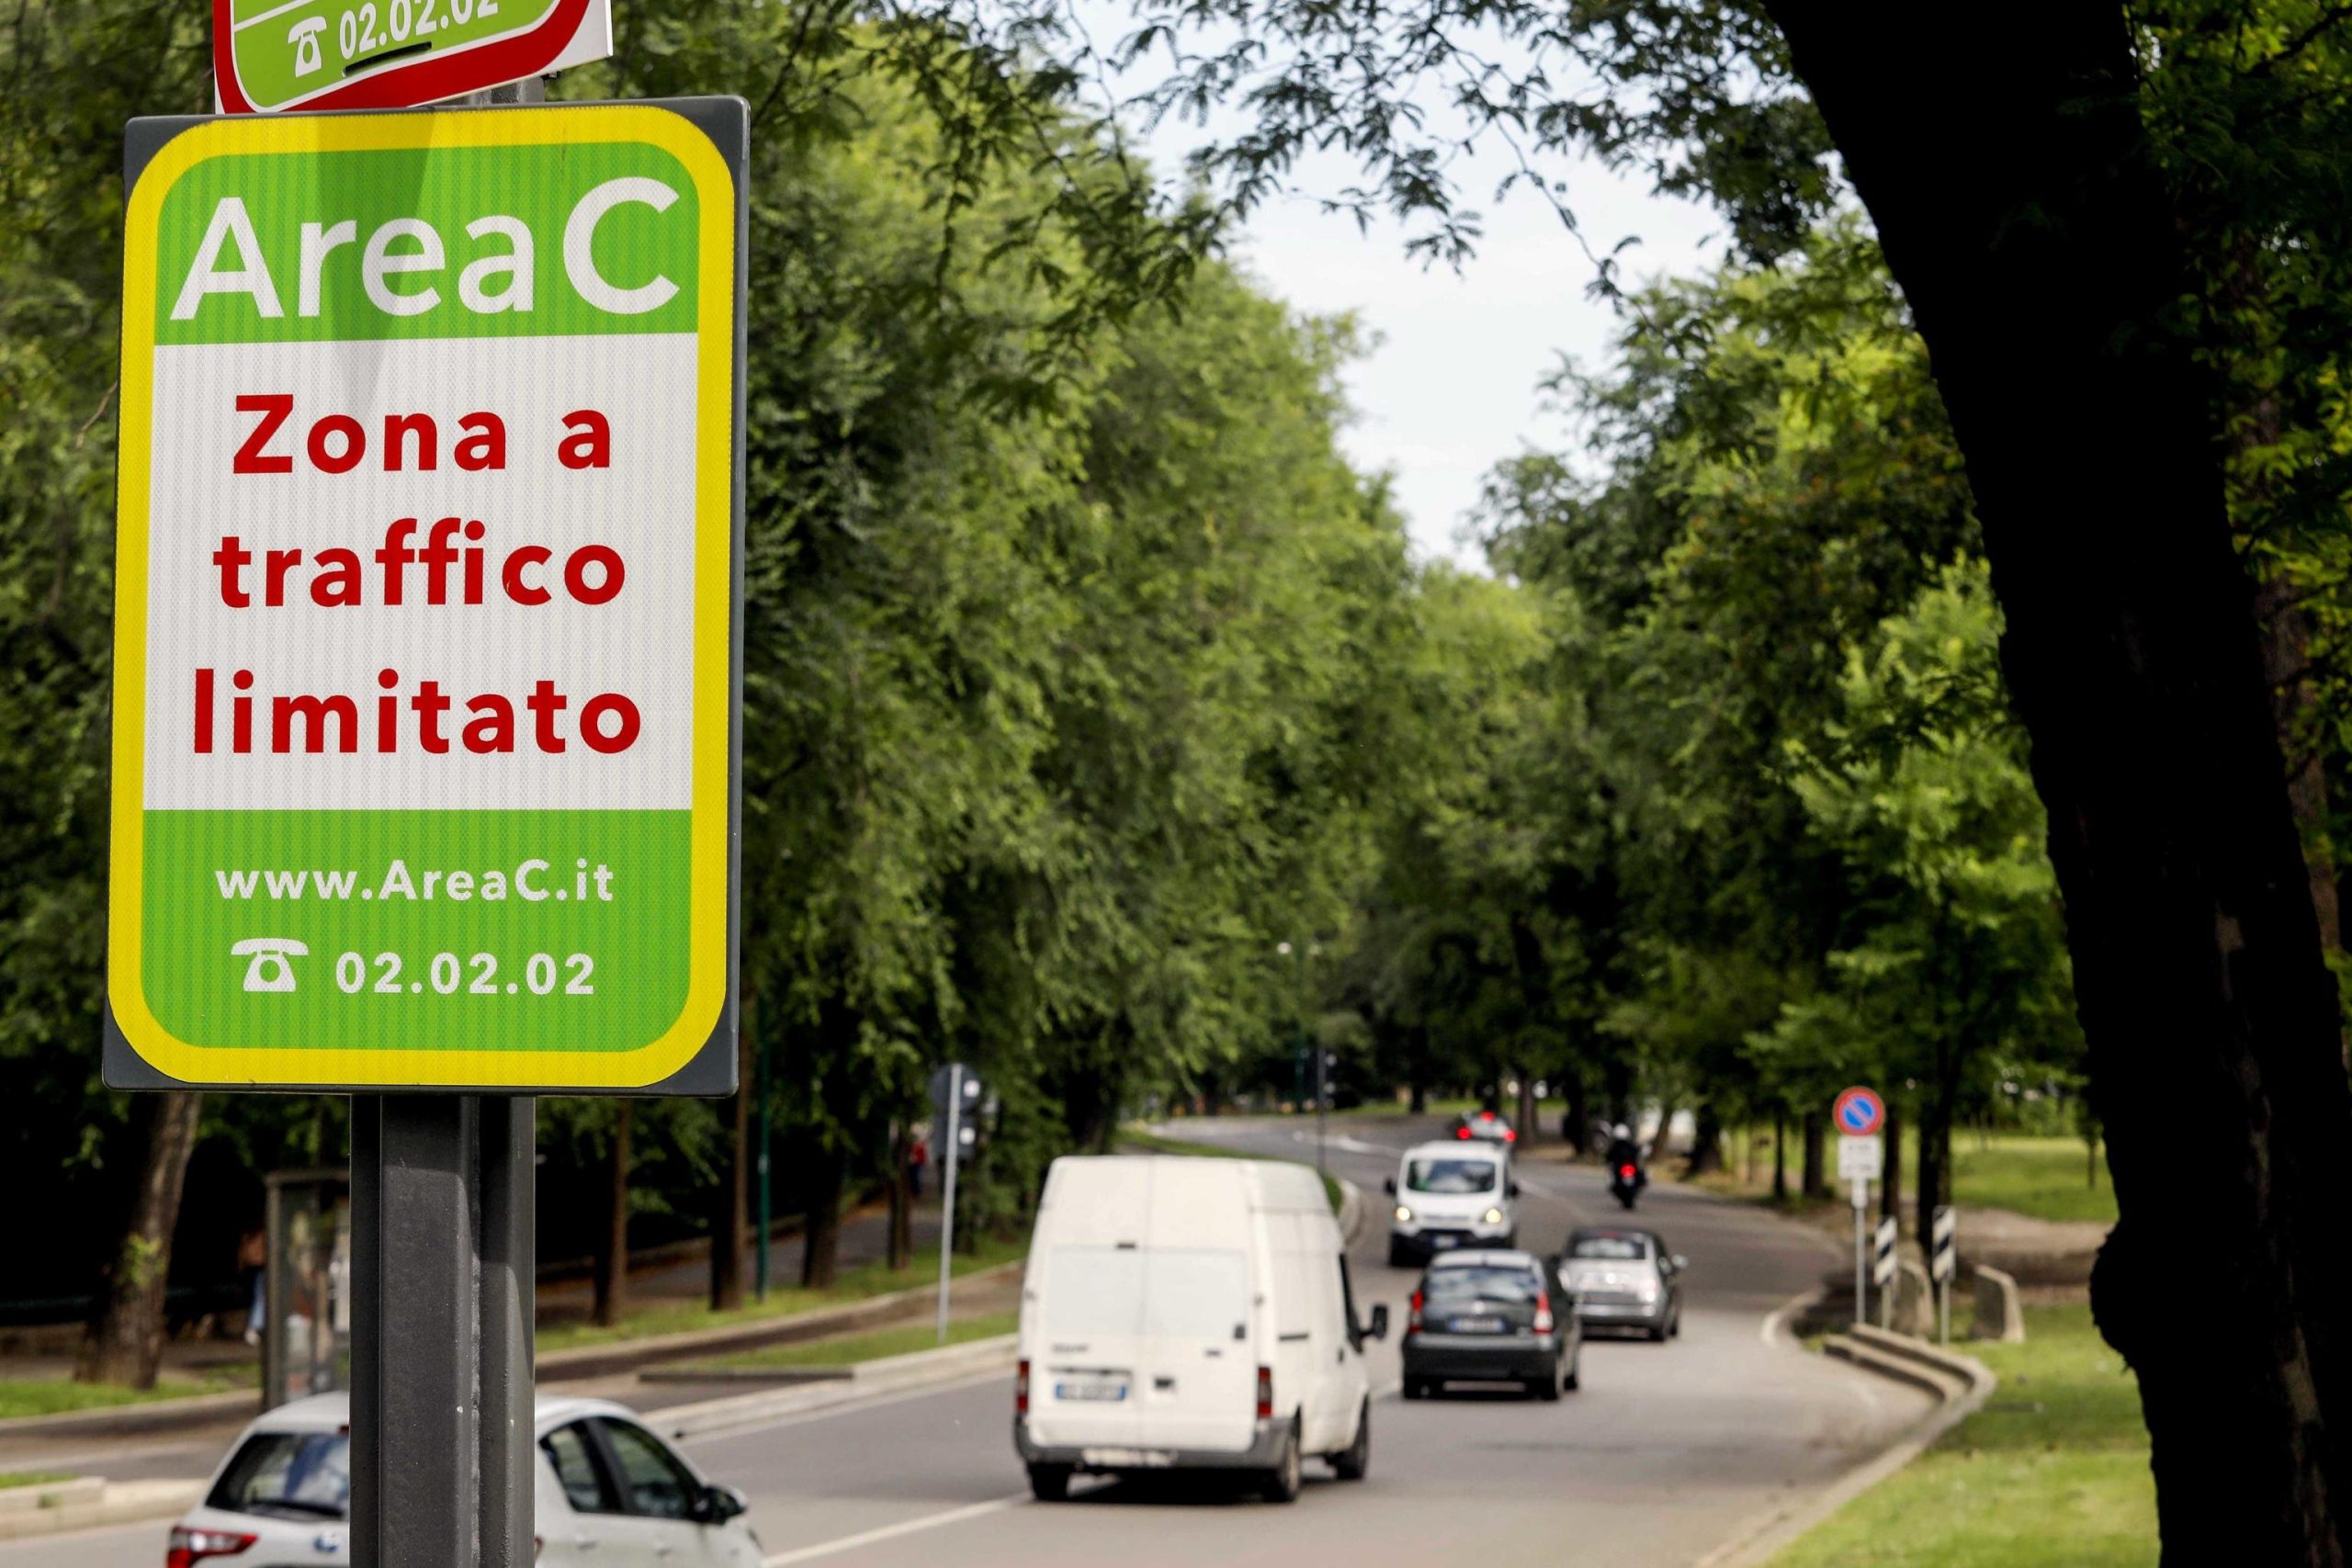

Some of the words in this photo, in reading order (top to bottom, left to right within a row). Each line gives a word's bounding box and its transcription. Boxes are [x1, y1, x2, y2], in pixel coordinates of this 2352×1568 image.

[169, 196, 535, 321] Area
[562, 175, 681, 315] C
[232, 393, 507, 475] Zona
[558, 409, 611, 470] a
[212, 516, 626, 609] traffico
[193, 668, 641, 755] limitato
[215, 858, 614, 902] www.AreaC.it
[335, 952, 594, 996] 02.02.02
